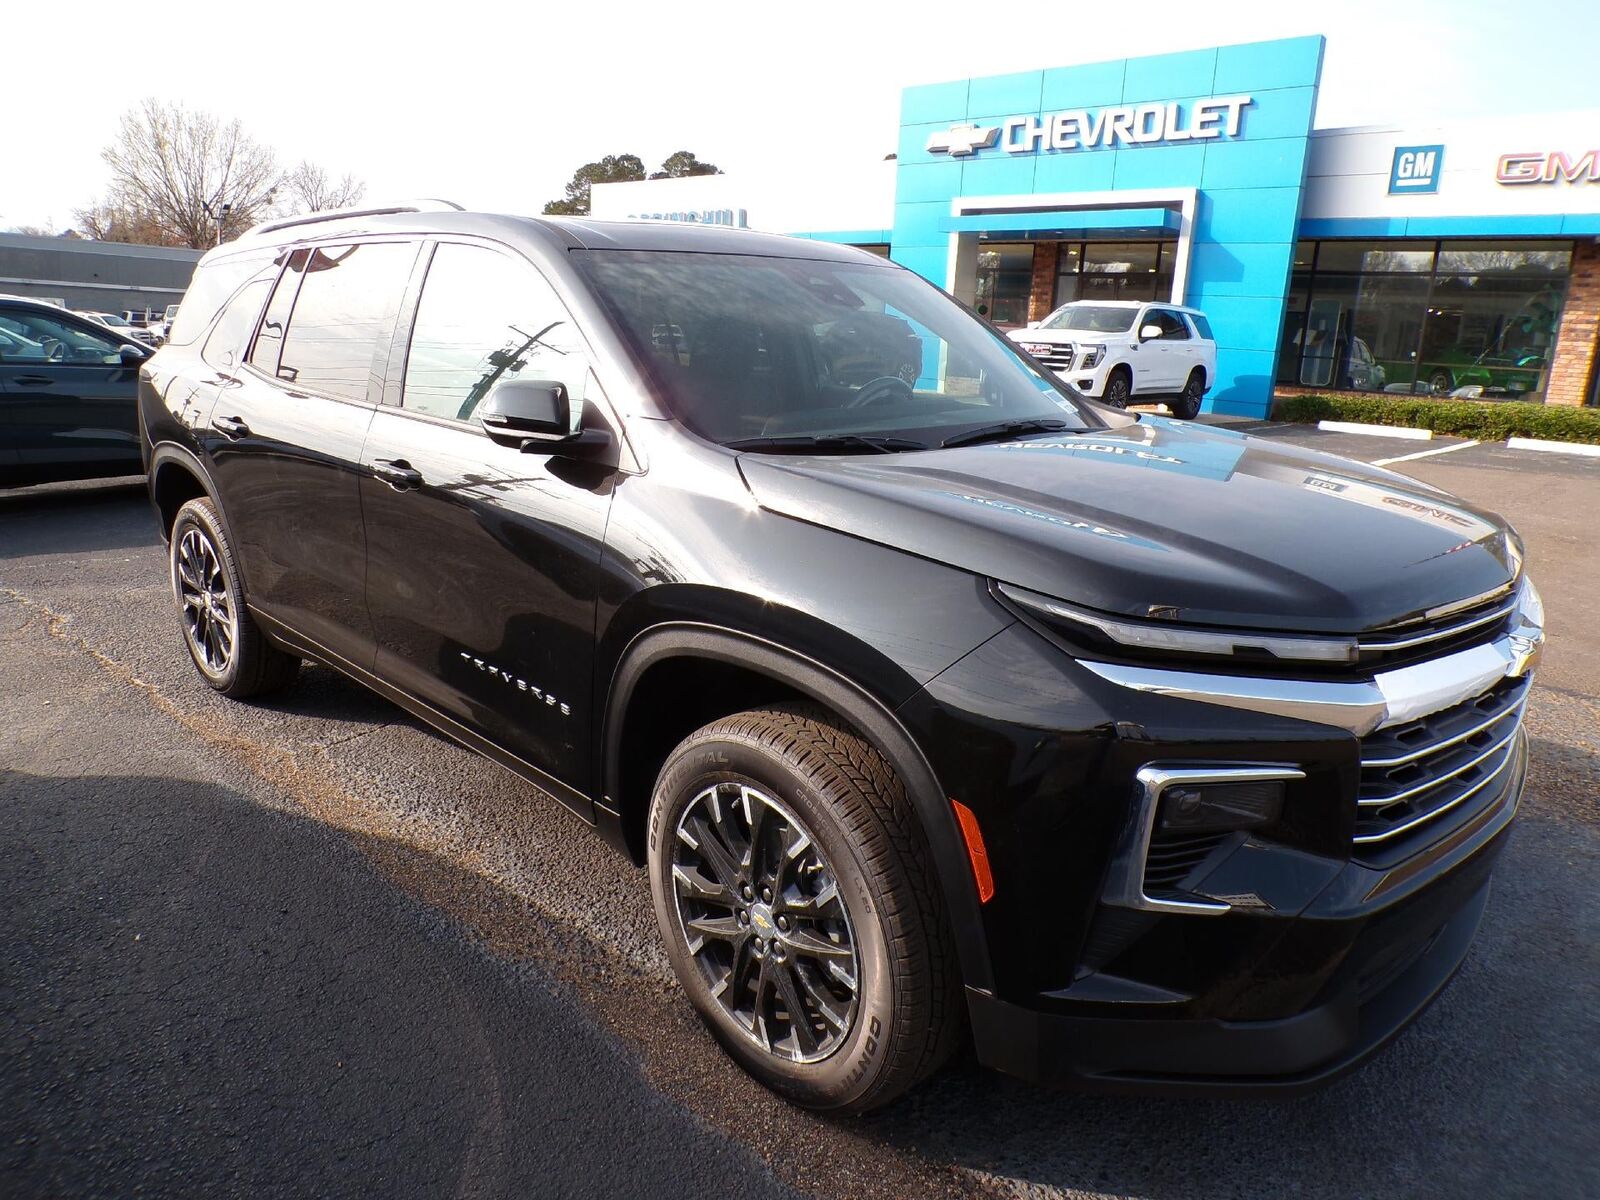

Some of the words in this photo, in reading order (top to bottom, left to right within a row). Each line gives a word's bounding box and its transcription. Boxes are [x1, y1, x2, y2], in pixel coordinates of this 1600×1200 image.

[1000, 94, 1252, 154] CHEVROLET
[1399, 151, 1436, 179] GM
[460, 652, 572, 717] TRAVERSE
